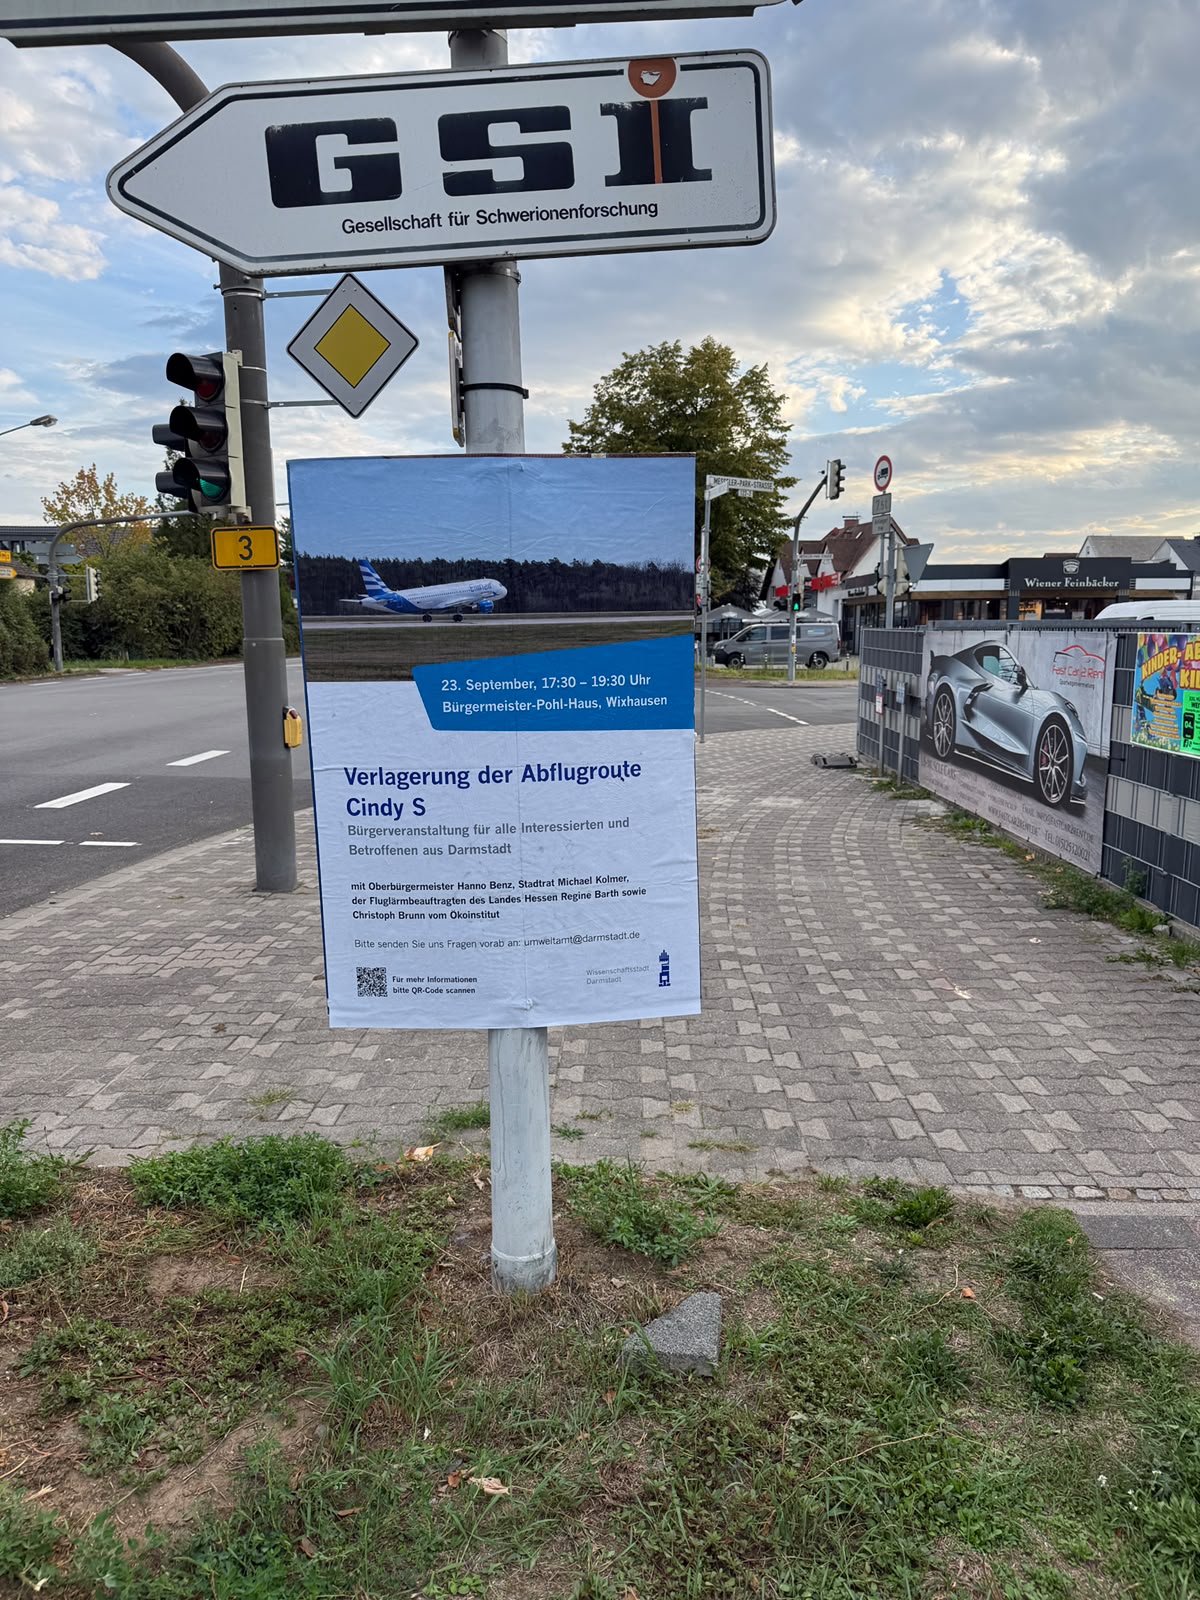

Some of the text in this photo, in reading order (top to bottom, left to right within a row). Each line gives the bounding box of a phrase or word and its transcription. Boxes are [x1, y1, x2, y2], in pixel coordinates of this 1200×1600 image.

[265, 97, 712, 208] GSI
[341, 200, 659, 235] Gesellschaft für Schwerionenforschung
[713, 477, 773, 490] MESSLER-PARK-STRASSE
[239, 535, 253, 561] 3
[1024, 576, 1119, 588] Wiener Feinbäcker
[1067, 666, 1080, 677] Car
[1080, 667, 1087, 678] 2
[1141, 646, 1182, 680] KINDER-
[441, 679, 461, 691] 23.
[466, 678, 537, 694] September,
[541, 676, 576, 689] 17:30
[591, 675, 626, 687] 19:30
[630, 674, 651, 686] Uhr
[443, 696, 667, 715] Bürgermeister-Pohl-Haus, Wixhausen
[344, 760, 642, 789] Verlagerung der Abflugroute
[346, 797, 426, 820] Cindy S
[347, 817, 630, 838] Bürgerveranstaltung für alle Interessierten und
[349, 843, 512, 855] Betroffenen aus Darmstadt
[351, 875, 629, 892] mit Oberbürgermeister Hanno Benz, Stadtrat Michael Kolmer,
[352, 887, 647, 907] der Fluglärmbeauftragten des Landes Hessen Regine Barth sowie
[352, 910, 395, 921] Christoph
[398, 911, 425, 919] Brunn
[450, 910, 500, 919] Ökoinstitut
[354, 939, 375, 948] Bitte
[378, 939, 409, 948] senden
[411, 940, 425, 948] Sie
[447, 940, 477, 950] Fragen
[479, 939, 504, 947] vorab
[507, 939, 521, 947] an:
[524, 931, 640, 947] umweltamt@darmstadt.de
[586, 965, 649, 976] Wissenschaftsstadt
[586, 976, 622, 985] Darmstadt
